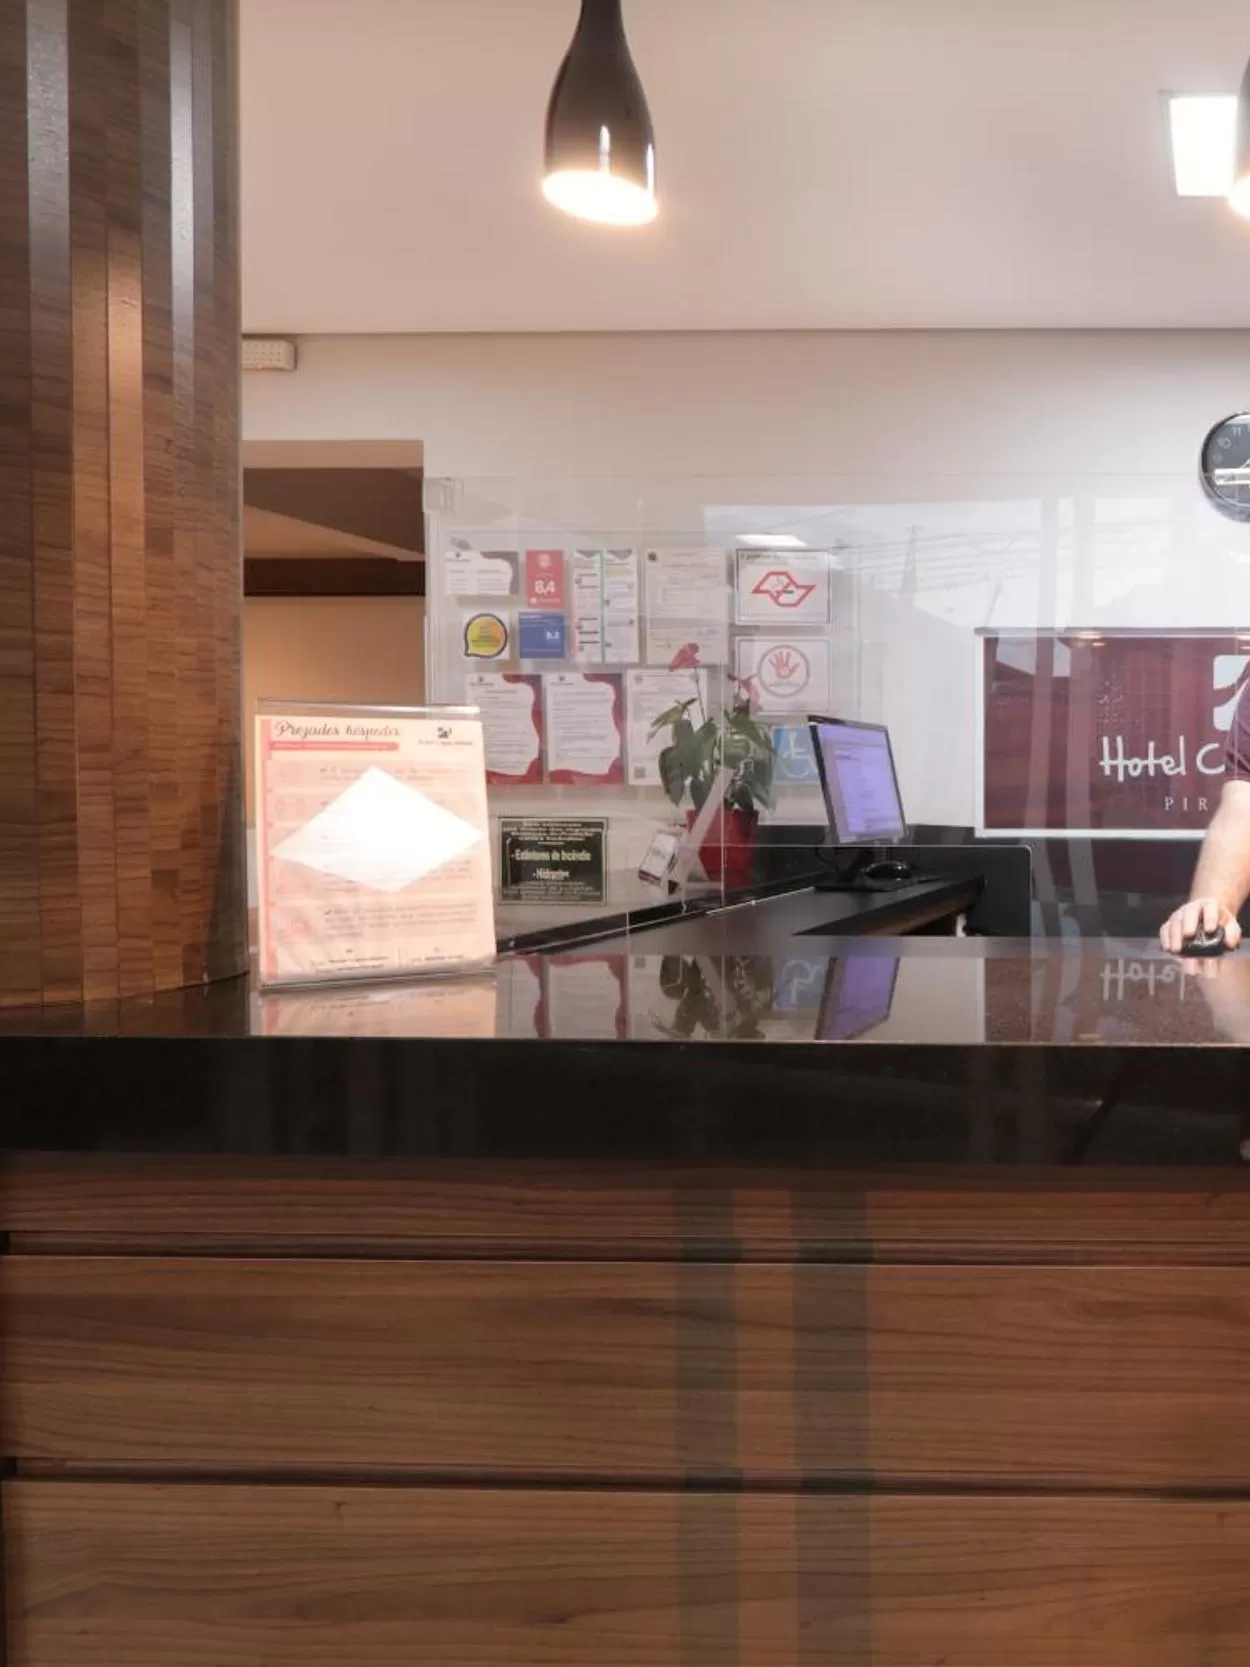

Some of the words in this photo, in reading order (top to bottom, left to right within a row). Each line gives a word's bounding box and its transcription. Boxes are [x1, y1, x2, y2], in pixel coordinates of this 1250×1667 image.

[1099, 735, 1187, 783] Hotel
[1196, 742, 1226, 775] C
[1163, 796, 1209, 811] PIR
